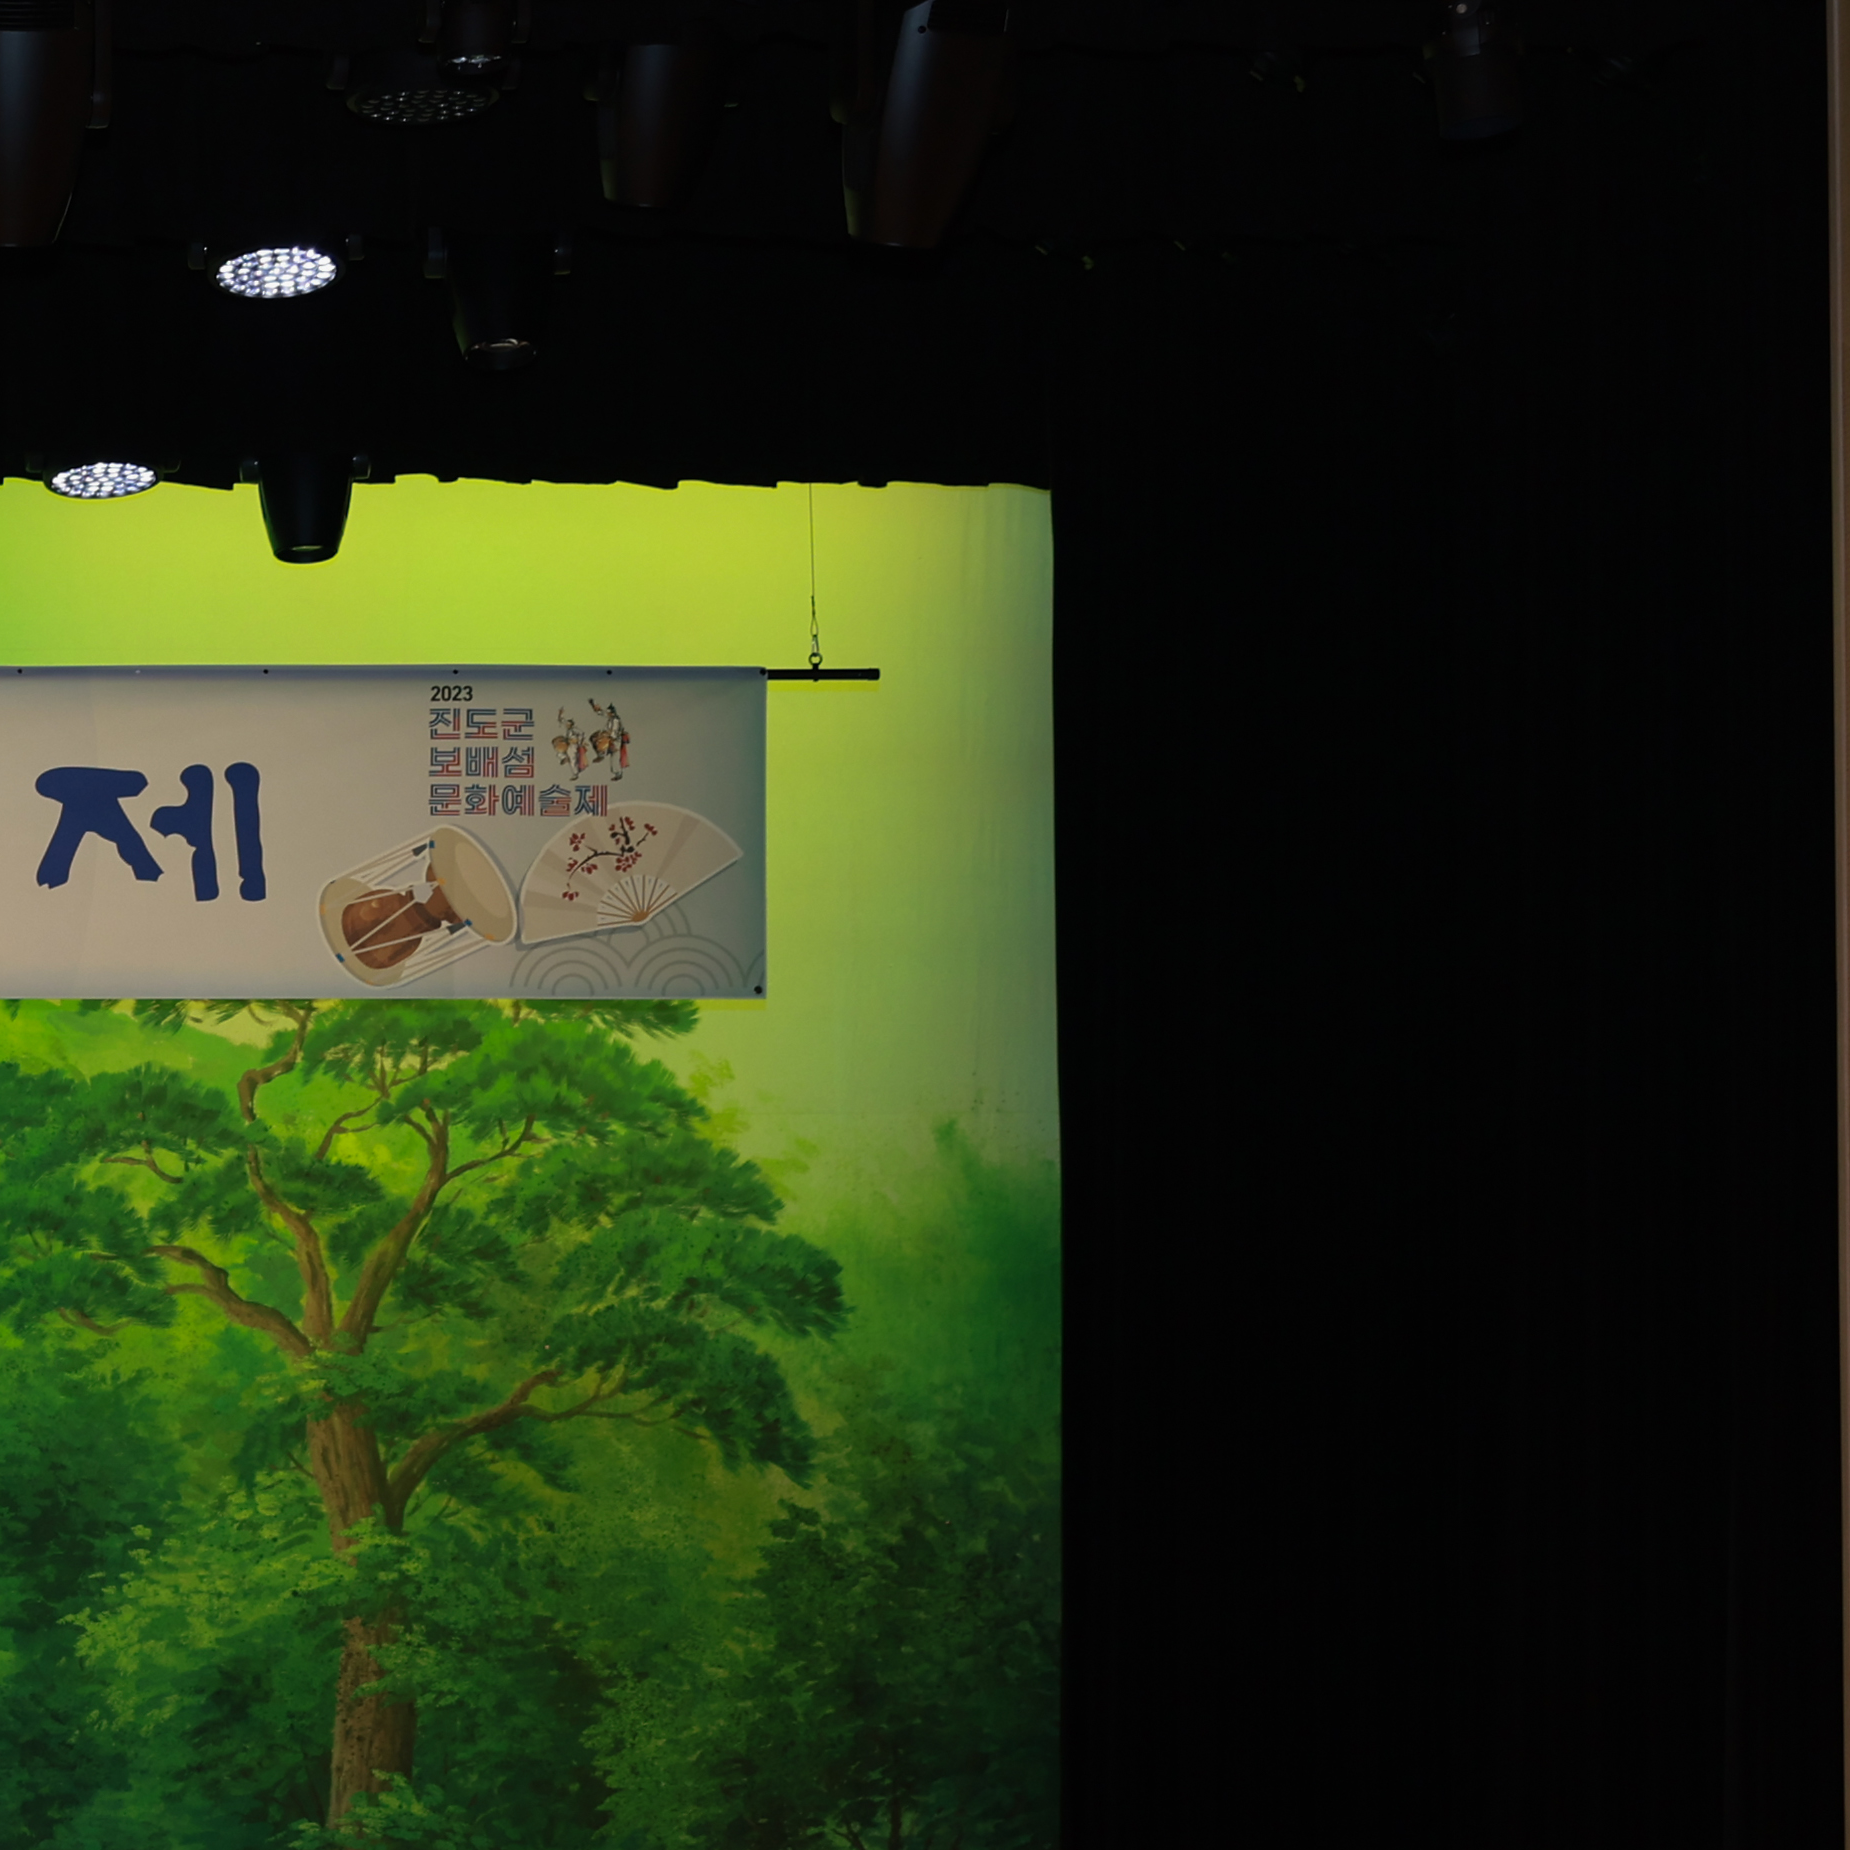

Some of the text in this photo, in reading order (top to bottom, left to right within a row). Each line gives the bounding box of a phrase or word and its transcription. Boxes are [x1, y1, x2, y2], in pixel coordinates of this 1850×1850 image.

[431, 686, 473, 702] 2023
[429, 708, 535, 740] 진도군
[428, 747, 535, 779] 보배섬
[428, 784, 608, 817] 문화예술제
